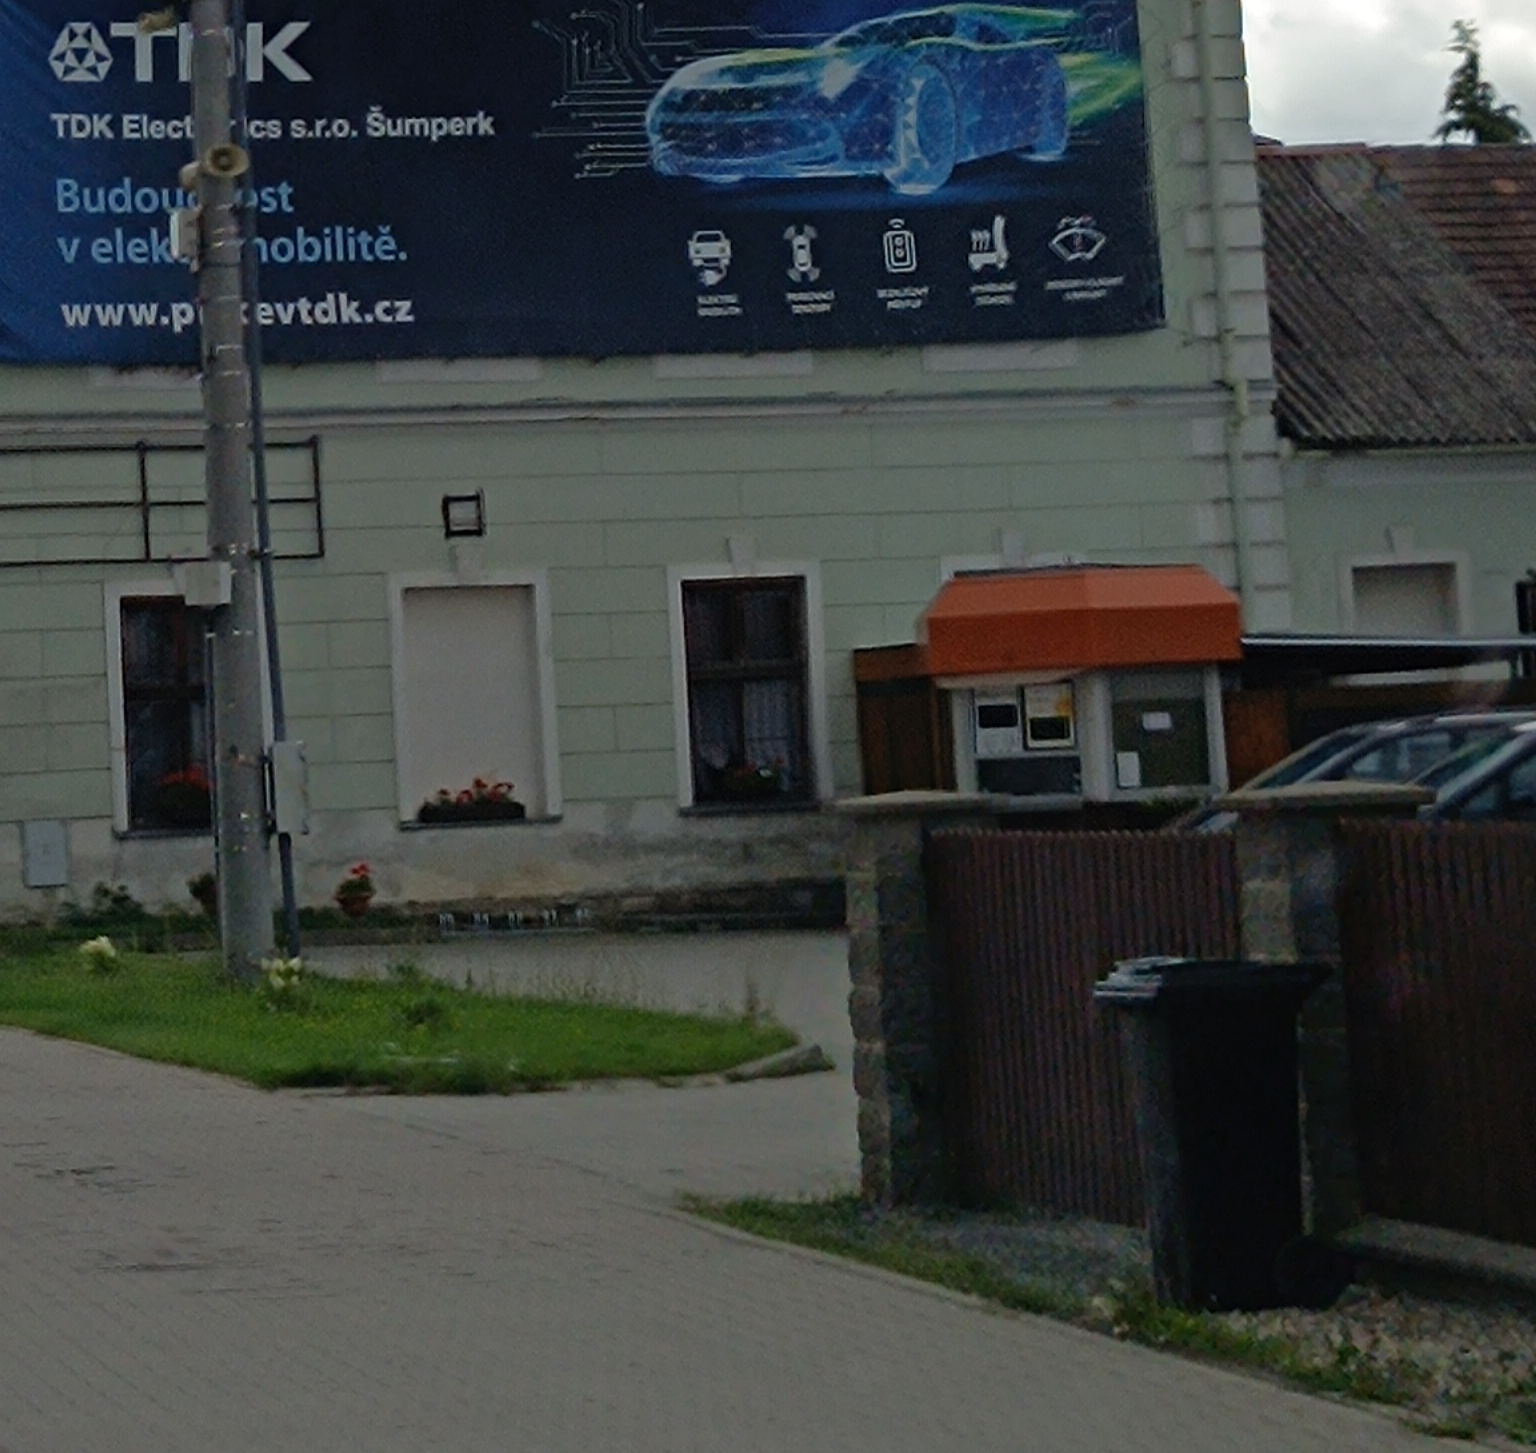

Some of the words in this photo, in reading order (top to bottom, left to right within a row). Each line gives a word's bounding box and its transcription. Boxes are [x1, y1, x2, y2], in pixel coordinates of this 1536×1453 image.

[50, 113, 114, 140] TDK
[290, 117, 359, 139] s.r.o.
[366, 104, 495, 142] Šumperk
[57, 238, 81, 263] v
